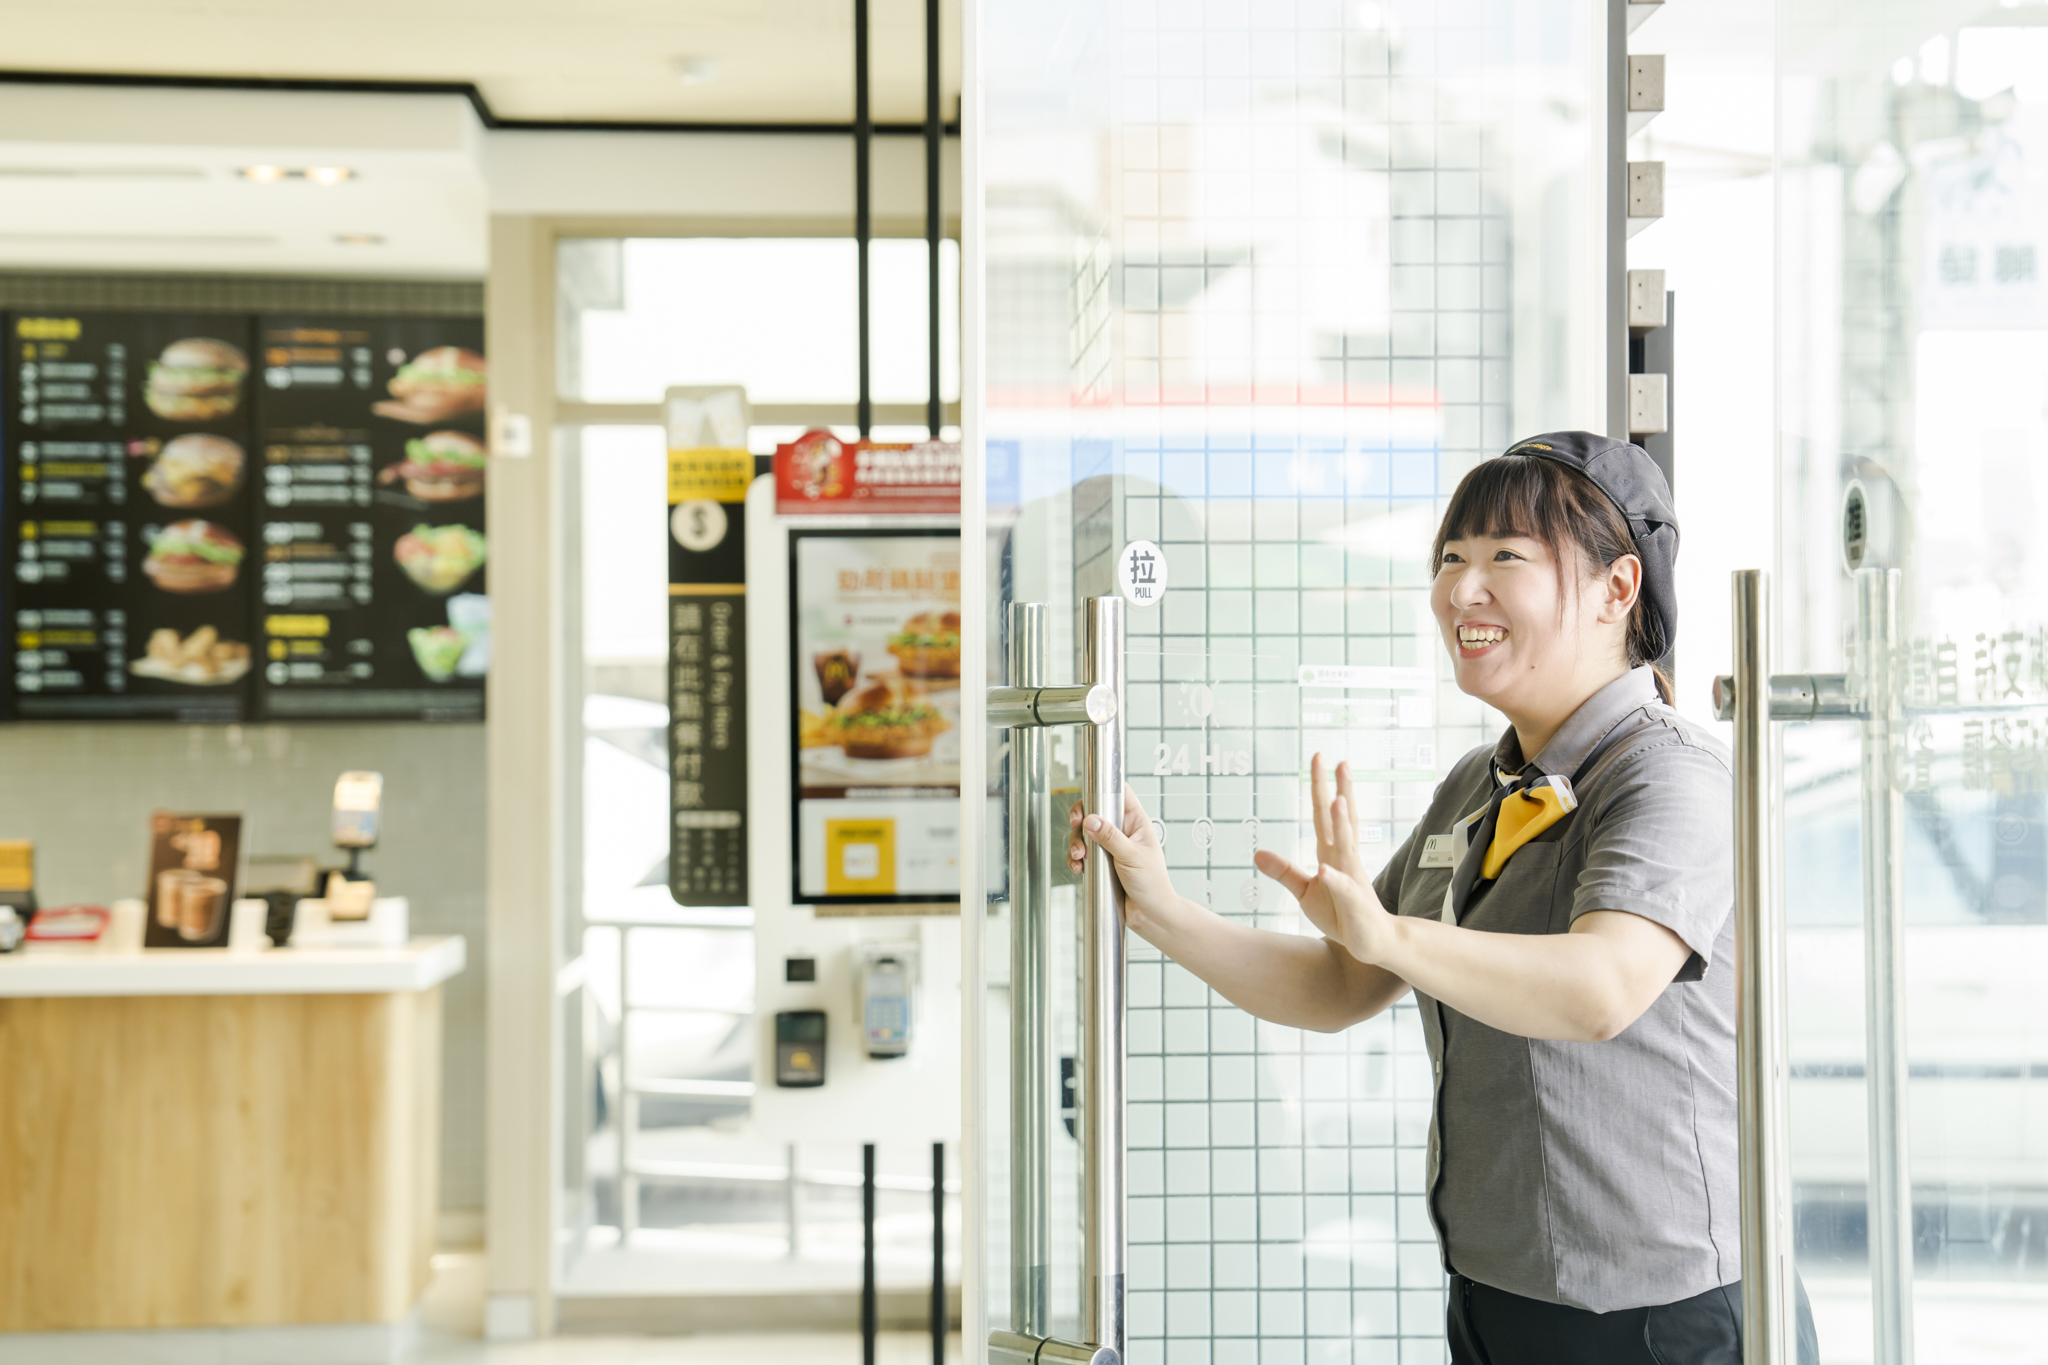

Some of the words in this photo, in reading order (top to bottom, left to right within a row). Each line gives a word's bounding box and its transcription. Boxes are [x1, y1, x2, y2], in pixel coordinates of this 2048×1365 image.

[1130, 550, 1157, 584] 拉
[1135, 587, 1153, 599] PULL
[1153, 743, 1191, 776] 24
[1200, 743, 1251, 776] Hrs
